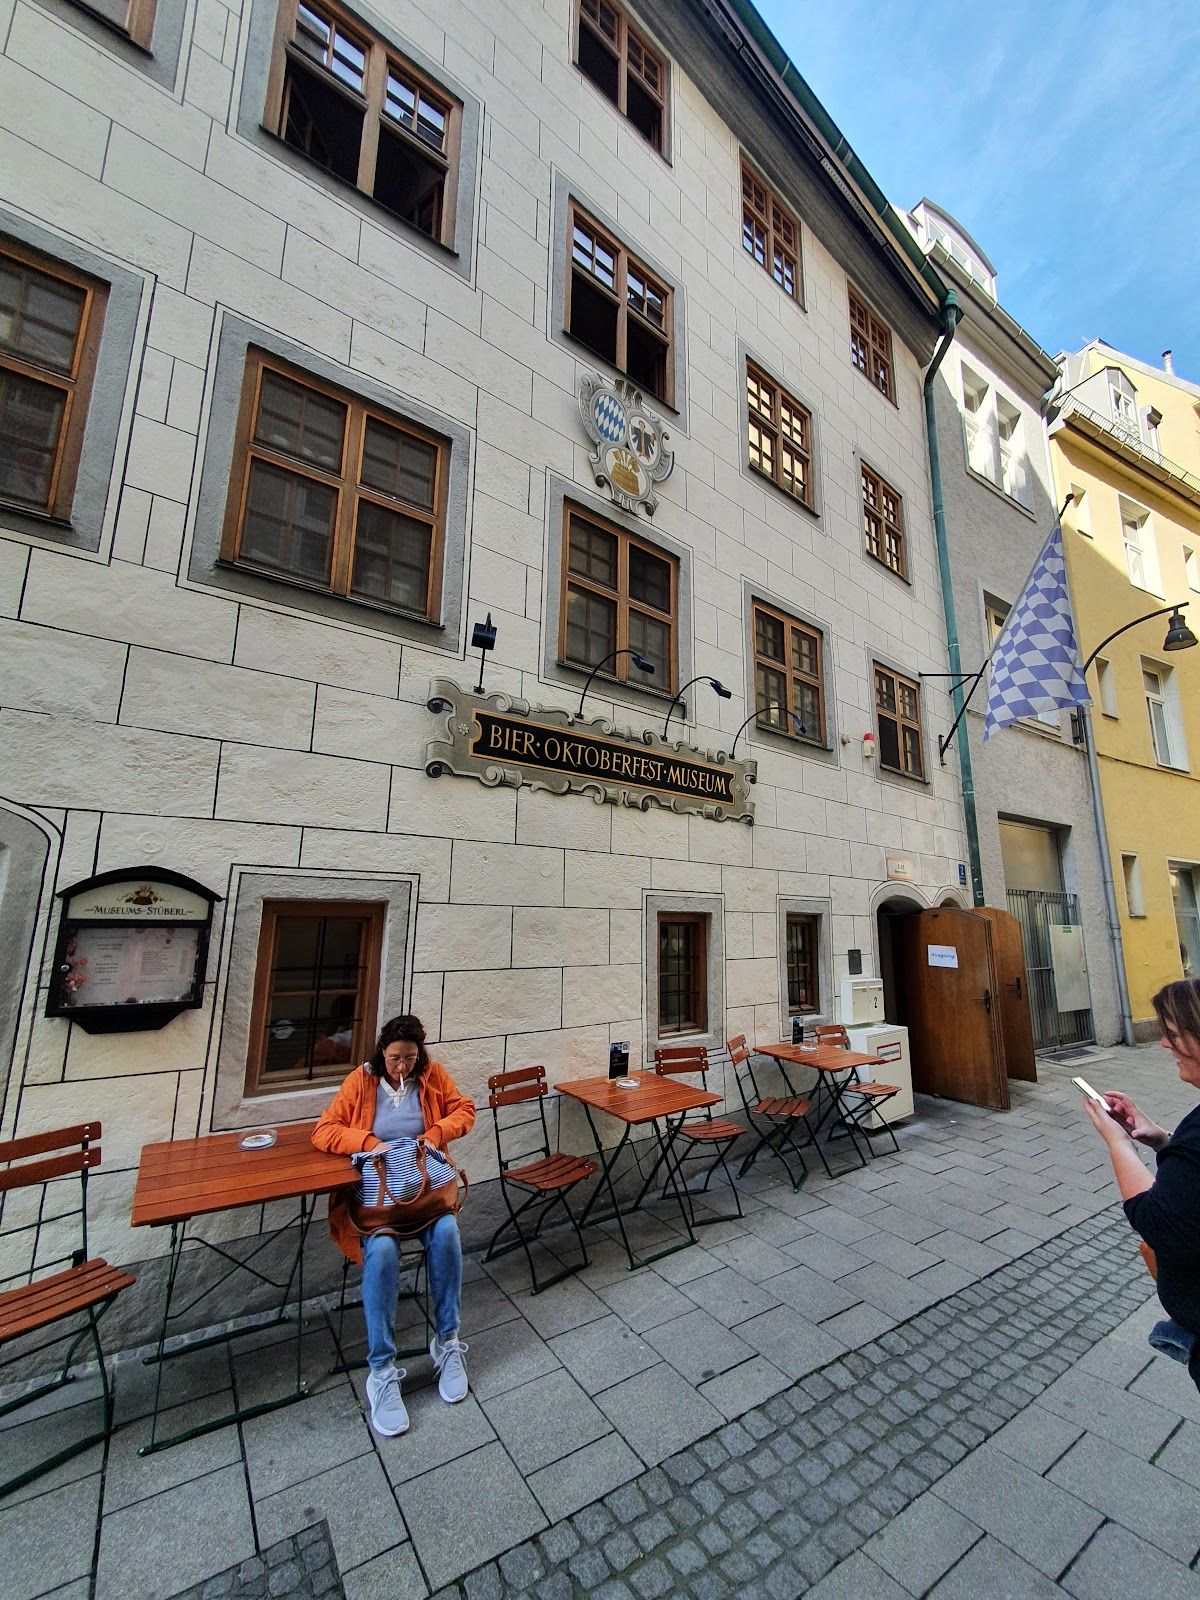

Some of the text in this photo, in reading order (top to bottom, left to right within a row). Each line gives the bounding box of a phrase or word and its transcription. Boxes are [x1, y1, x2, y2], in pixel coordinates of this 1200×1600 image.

[489, 724, 726, 795] BIER OKTOBERFEST MUSEUM
